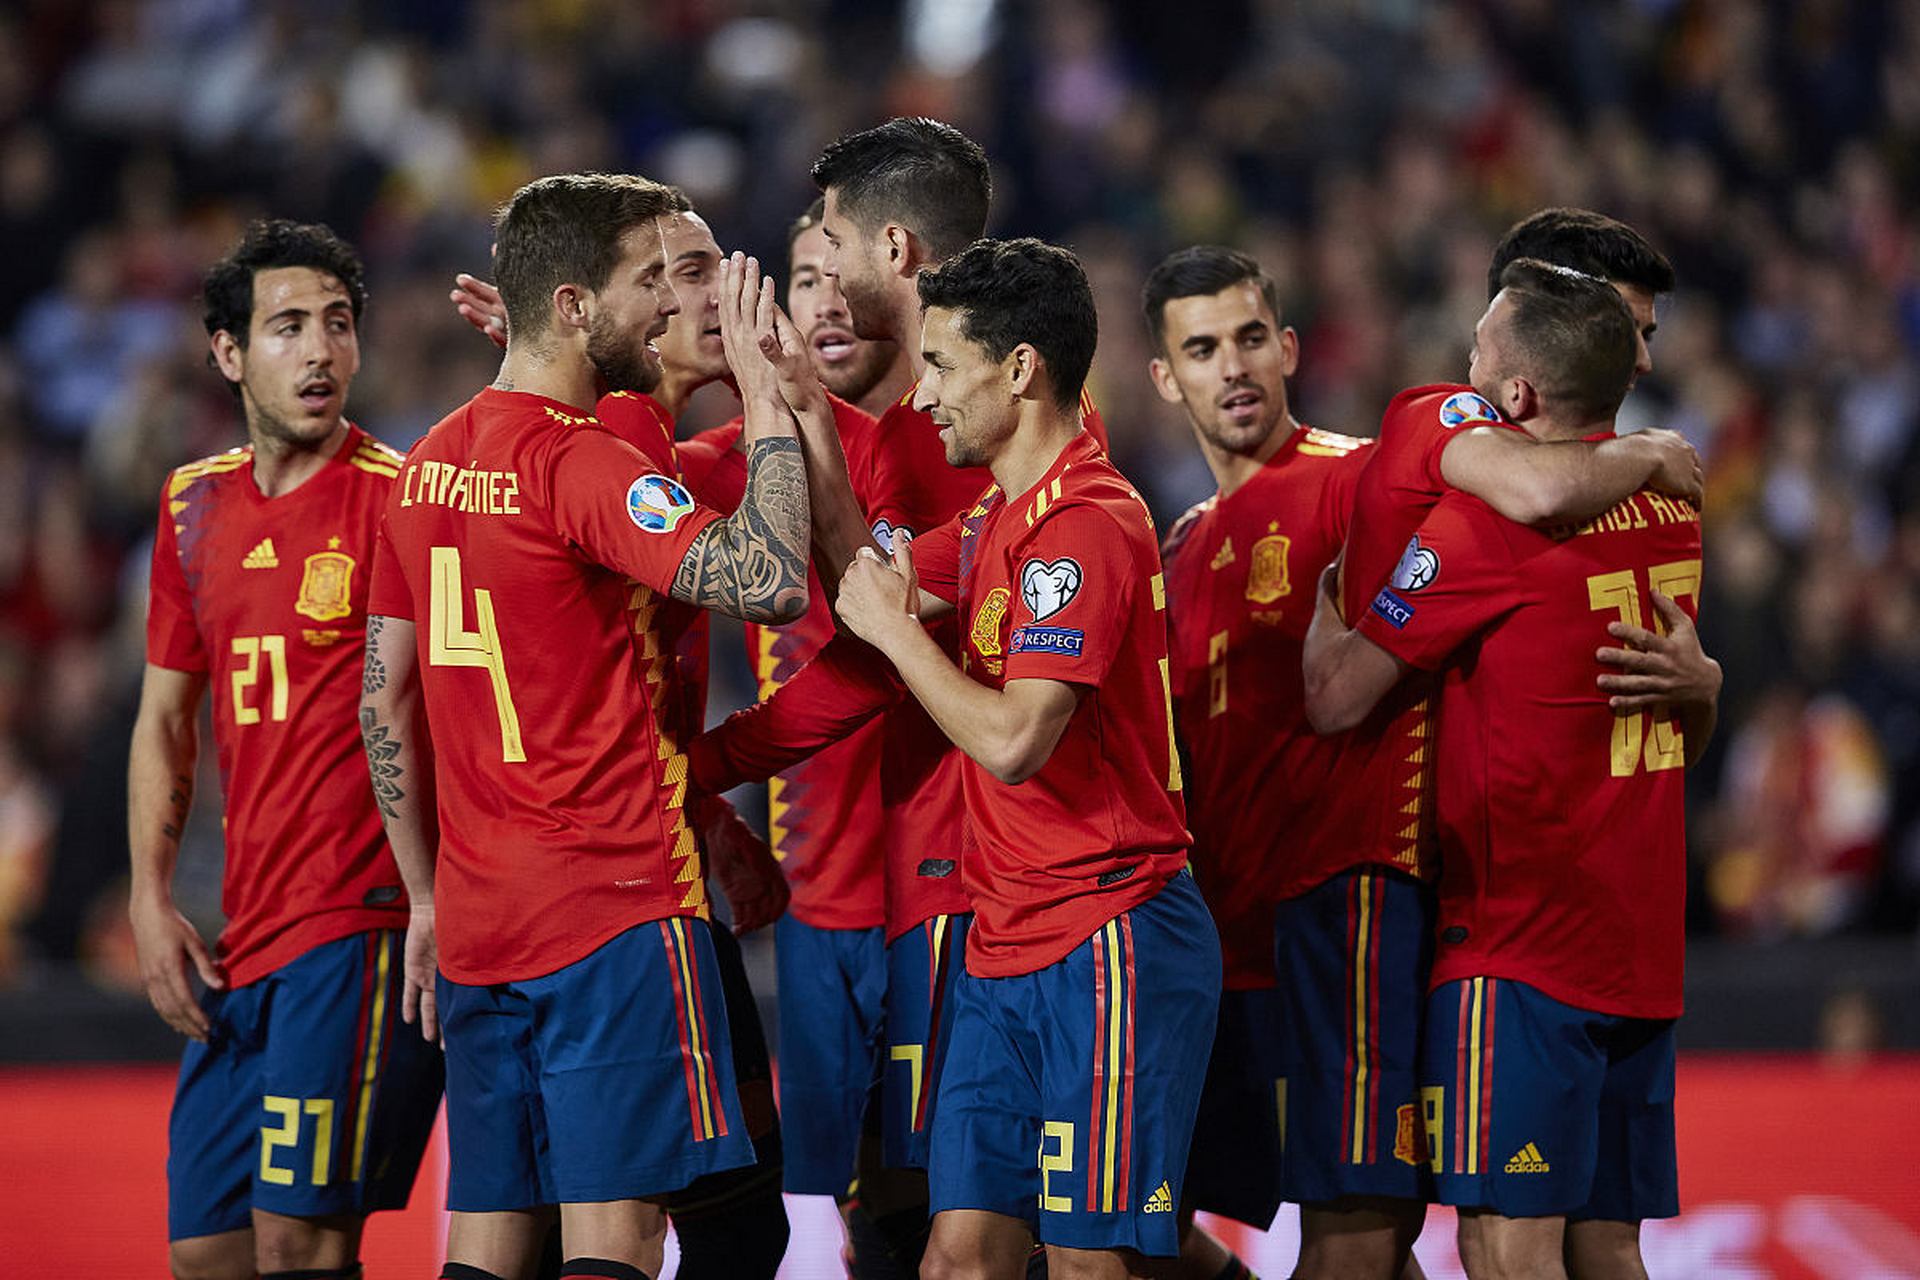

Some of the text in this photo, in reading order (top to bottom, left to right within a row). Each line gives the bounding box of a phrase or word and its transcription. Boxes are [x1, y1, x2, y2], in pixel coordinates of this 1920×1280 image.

[231, 635, 289, 725] 21
[429, 547, 528, 763] 4
[1025, 633, 1083, 649] RESPECT
[891, 1045, 923, 1134] 7
[260, 1095, 334, 1185] 21
[1504, 1161, 1550, 1174] adidas
